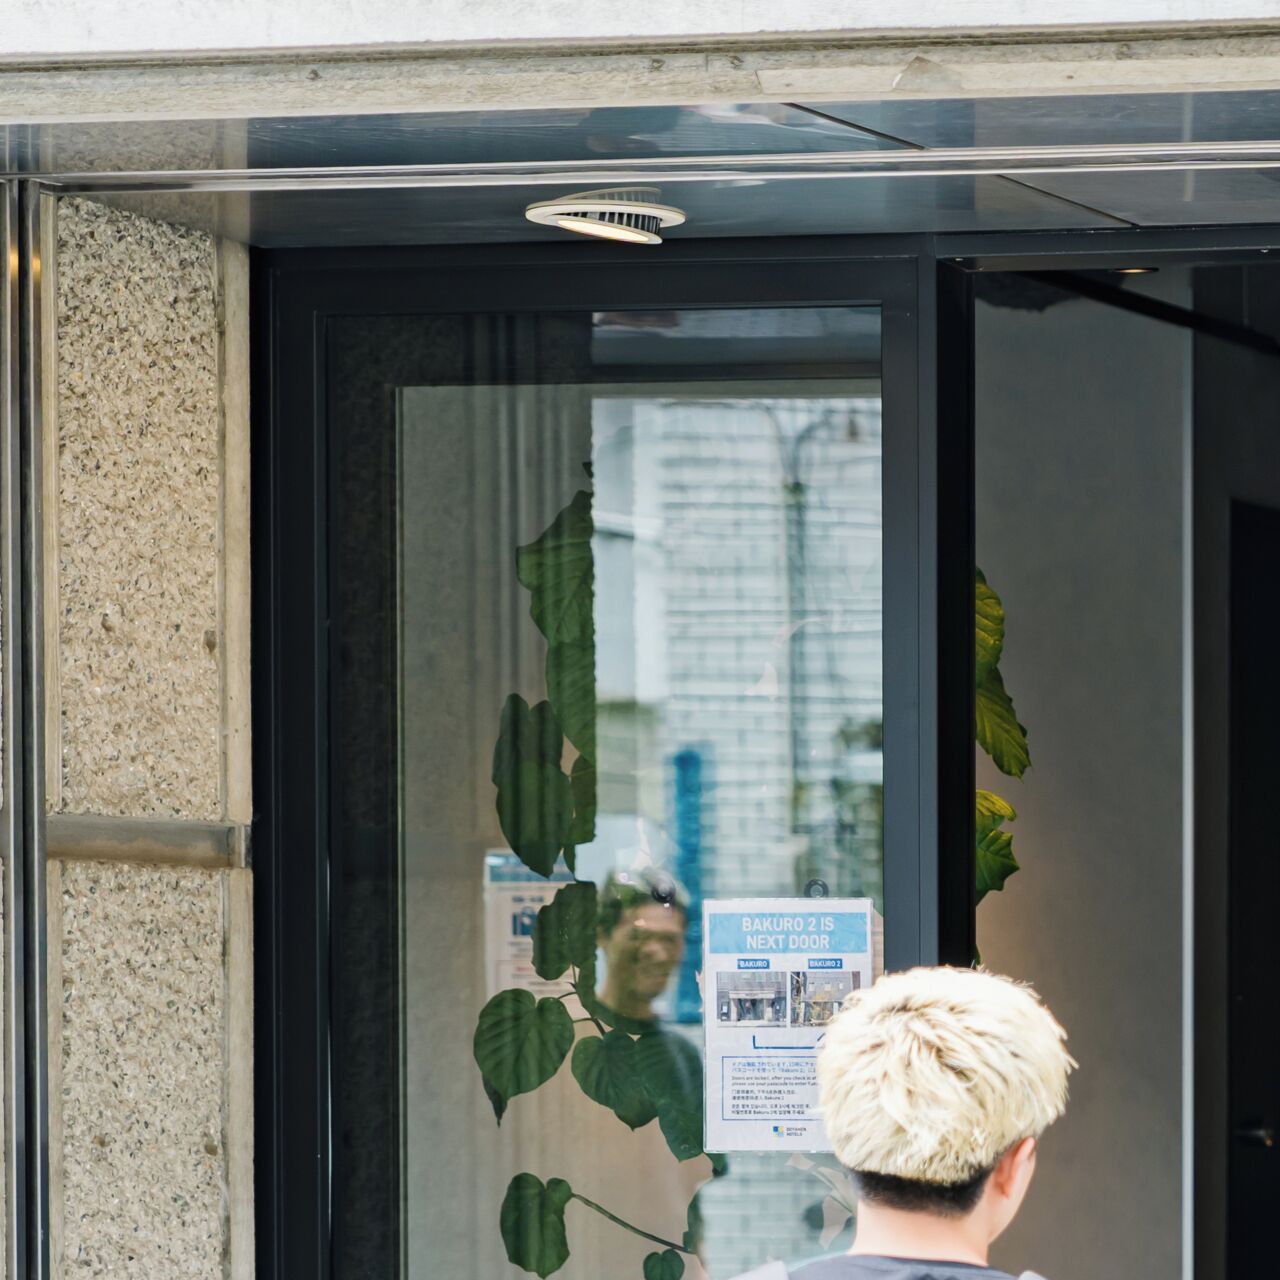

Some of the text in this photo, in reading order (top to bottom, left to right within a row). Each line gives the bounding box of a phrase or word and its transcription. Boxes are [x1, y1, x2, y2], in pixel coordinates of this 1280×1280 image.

[742, 916, 835, 932] BAKURO 2 IS
[746, 935, 830, 949] NEXT DOOR
[739, 960, 768, 968] BAKURO
